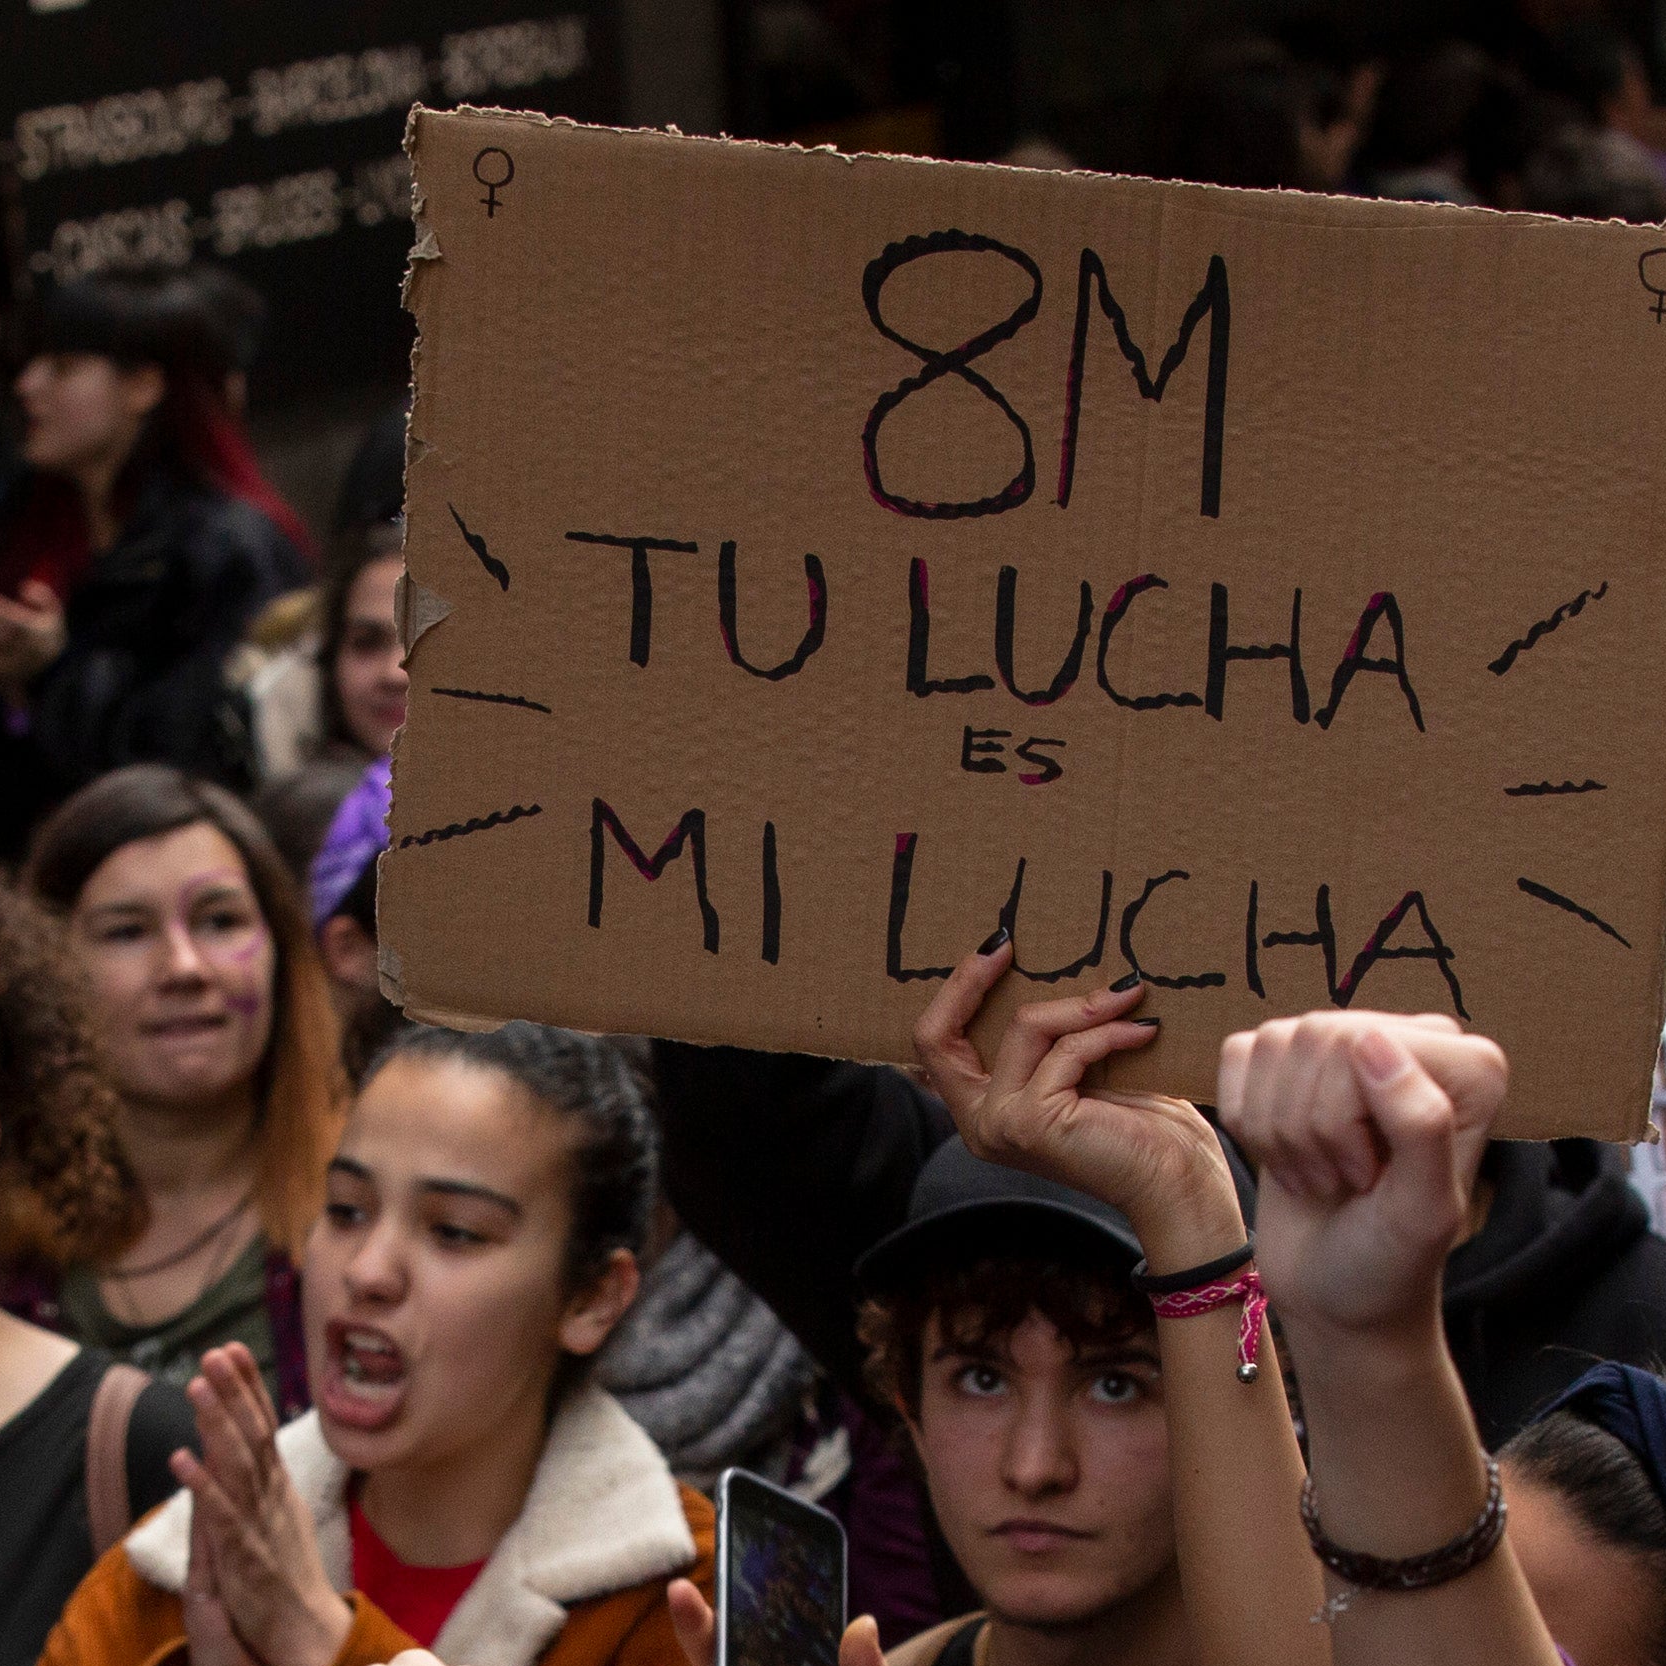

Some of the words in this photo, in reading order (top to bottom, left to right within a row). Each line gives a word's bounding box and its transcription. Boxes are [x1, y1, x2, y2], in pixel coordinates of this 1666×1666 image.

[862, 227, 1230, 520] 8M
[564, 531, 827, 681] TU
[906, 556, 1425, 733] LUCHA
[959, 726, 1067, 787] ES
[588, 798, 782, 964] MI
[886, 832, 1470, 1022] LUCHA
